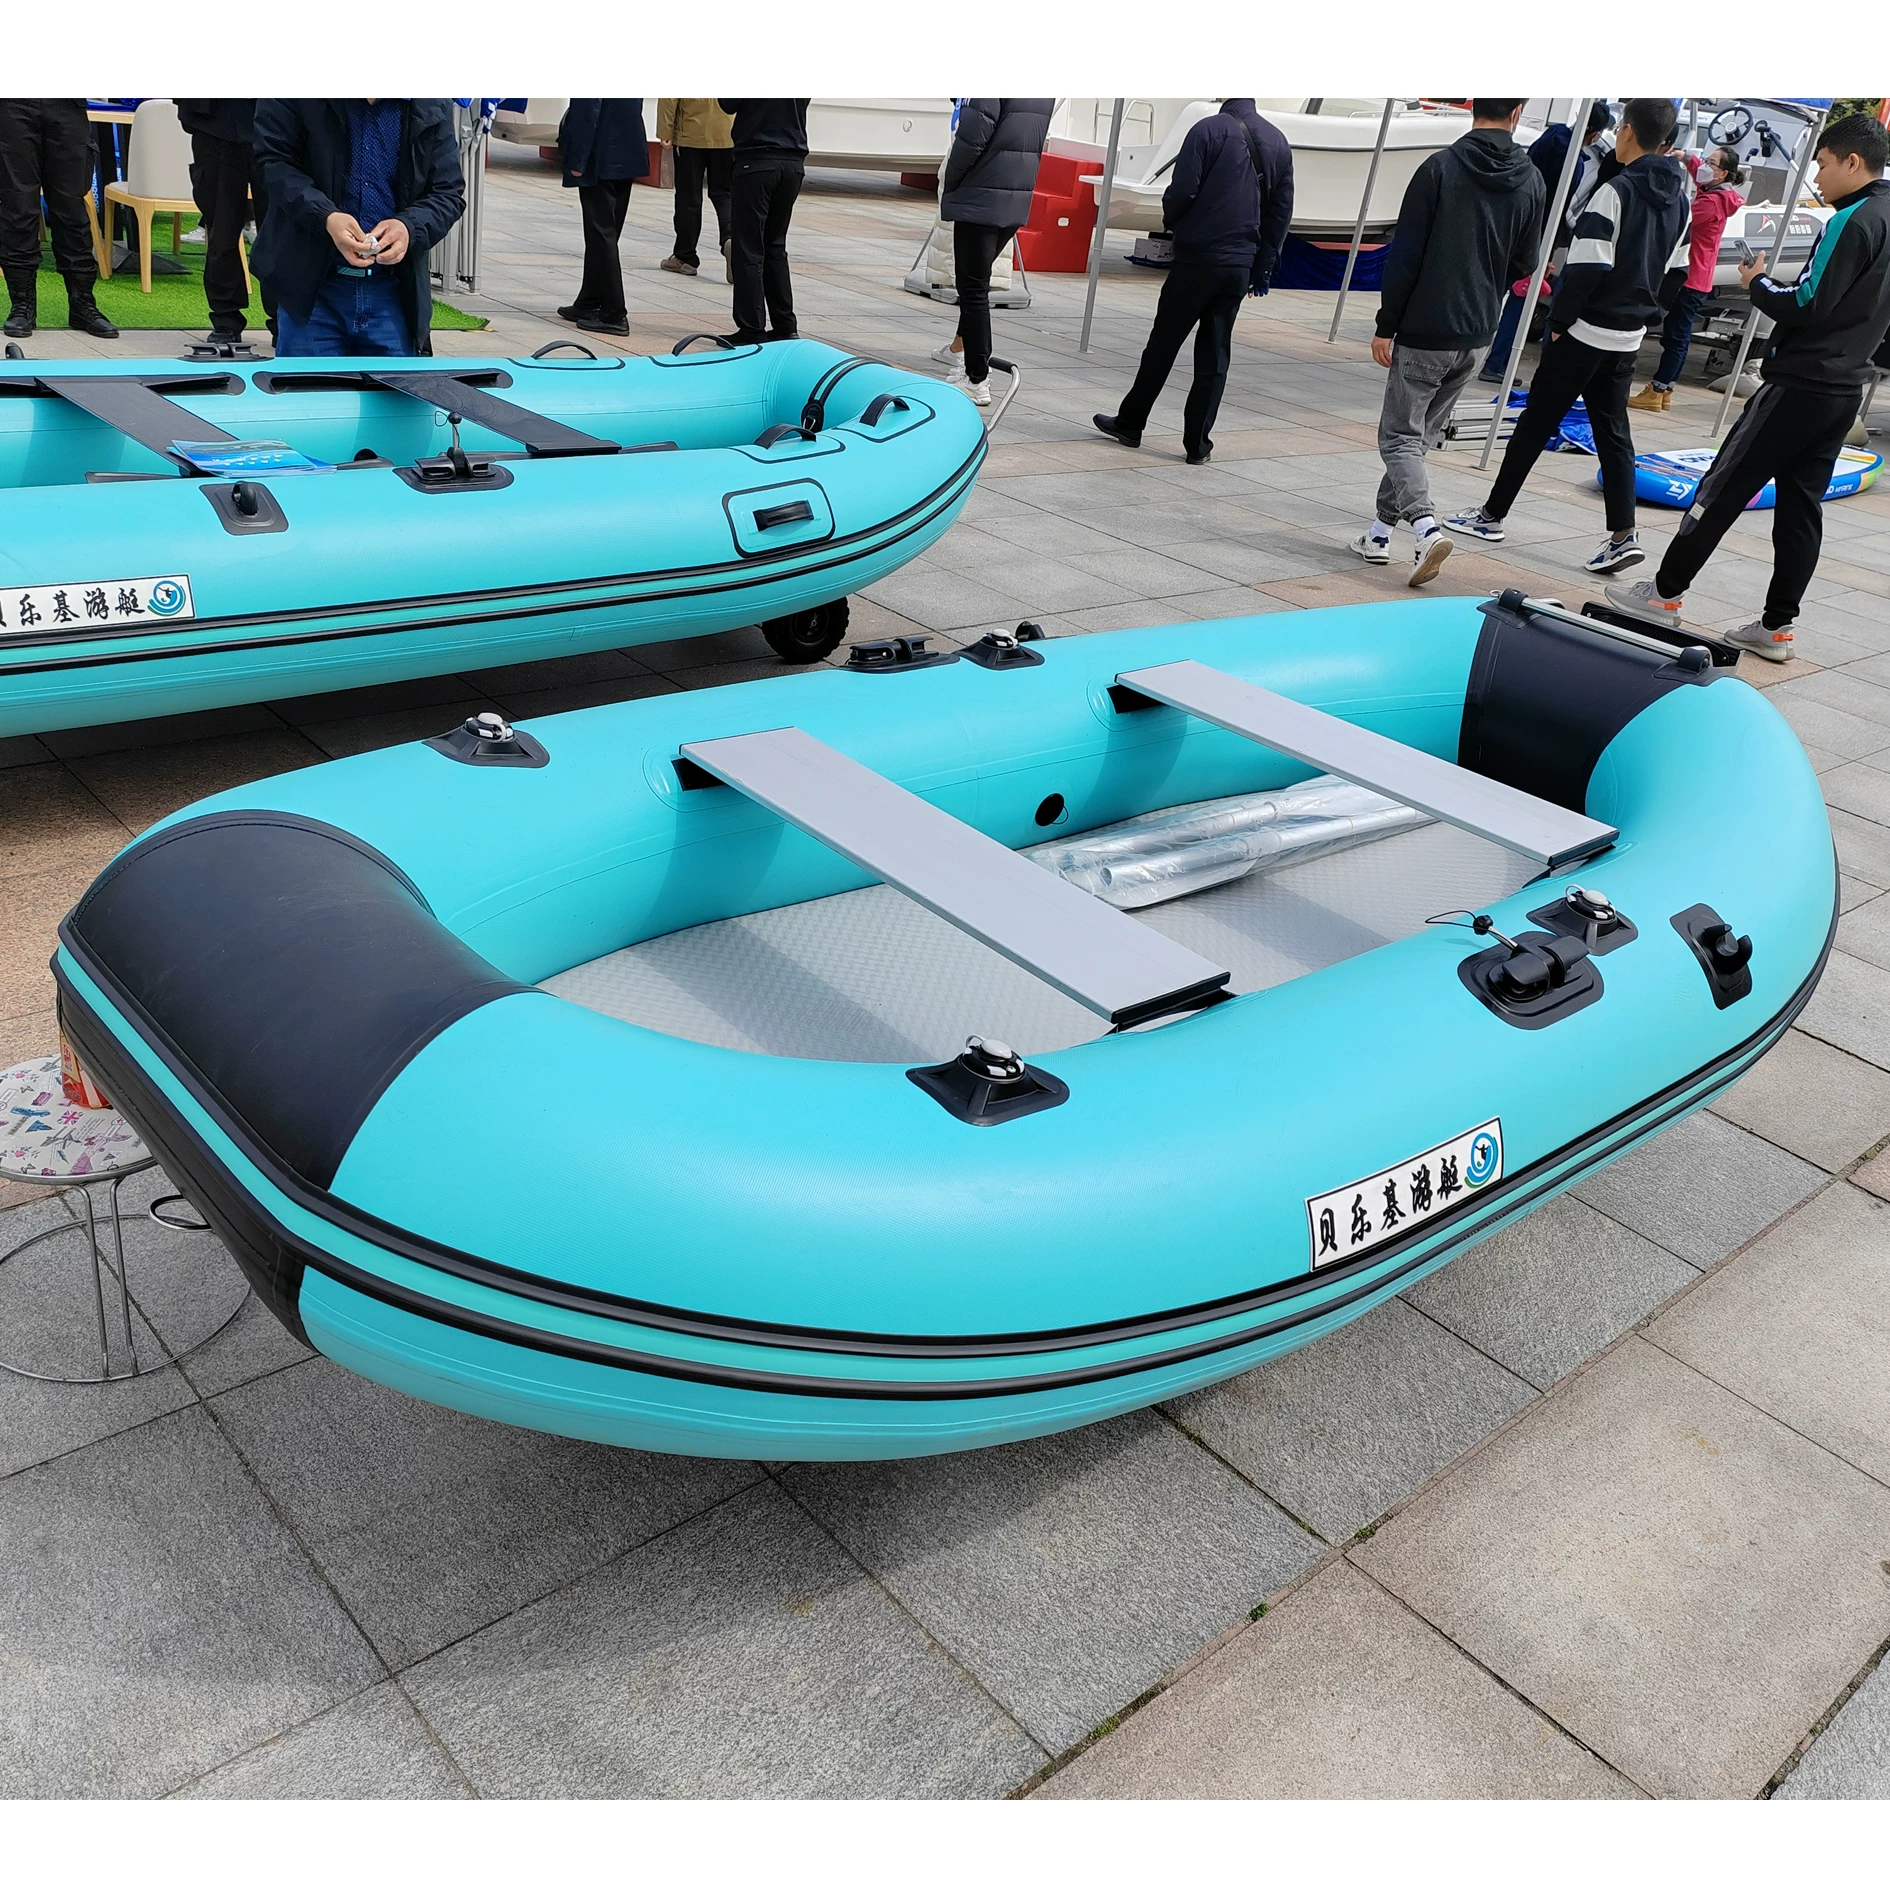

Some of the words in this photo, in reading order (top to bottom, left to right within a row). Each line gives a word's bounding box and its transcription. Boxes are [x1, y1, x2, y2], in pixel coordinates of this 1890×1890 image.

[1318, 1155, 1463, 1256] 贝乐基游艇
